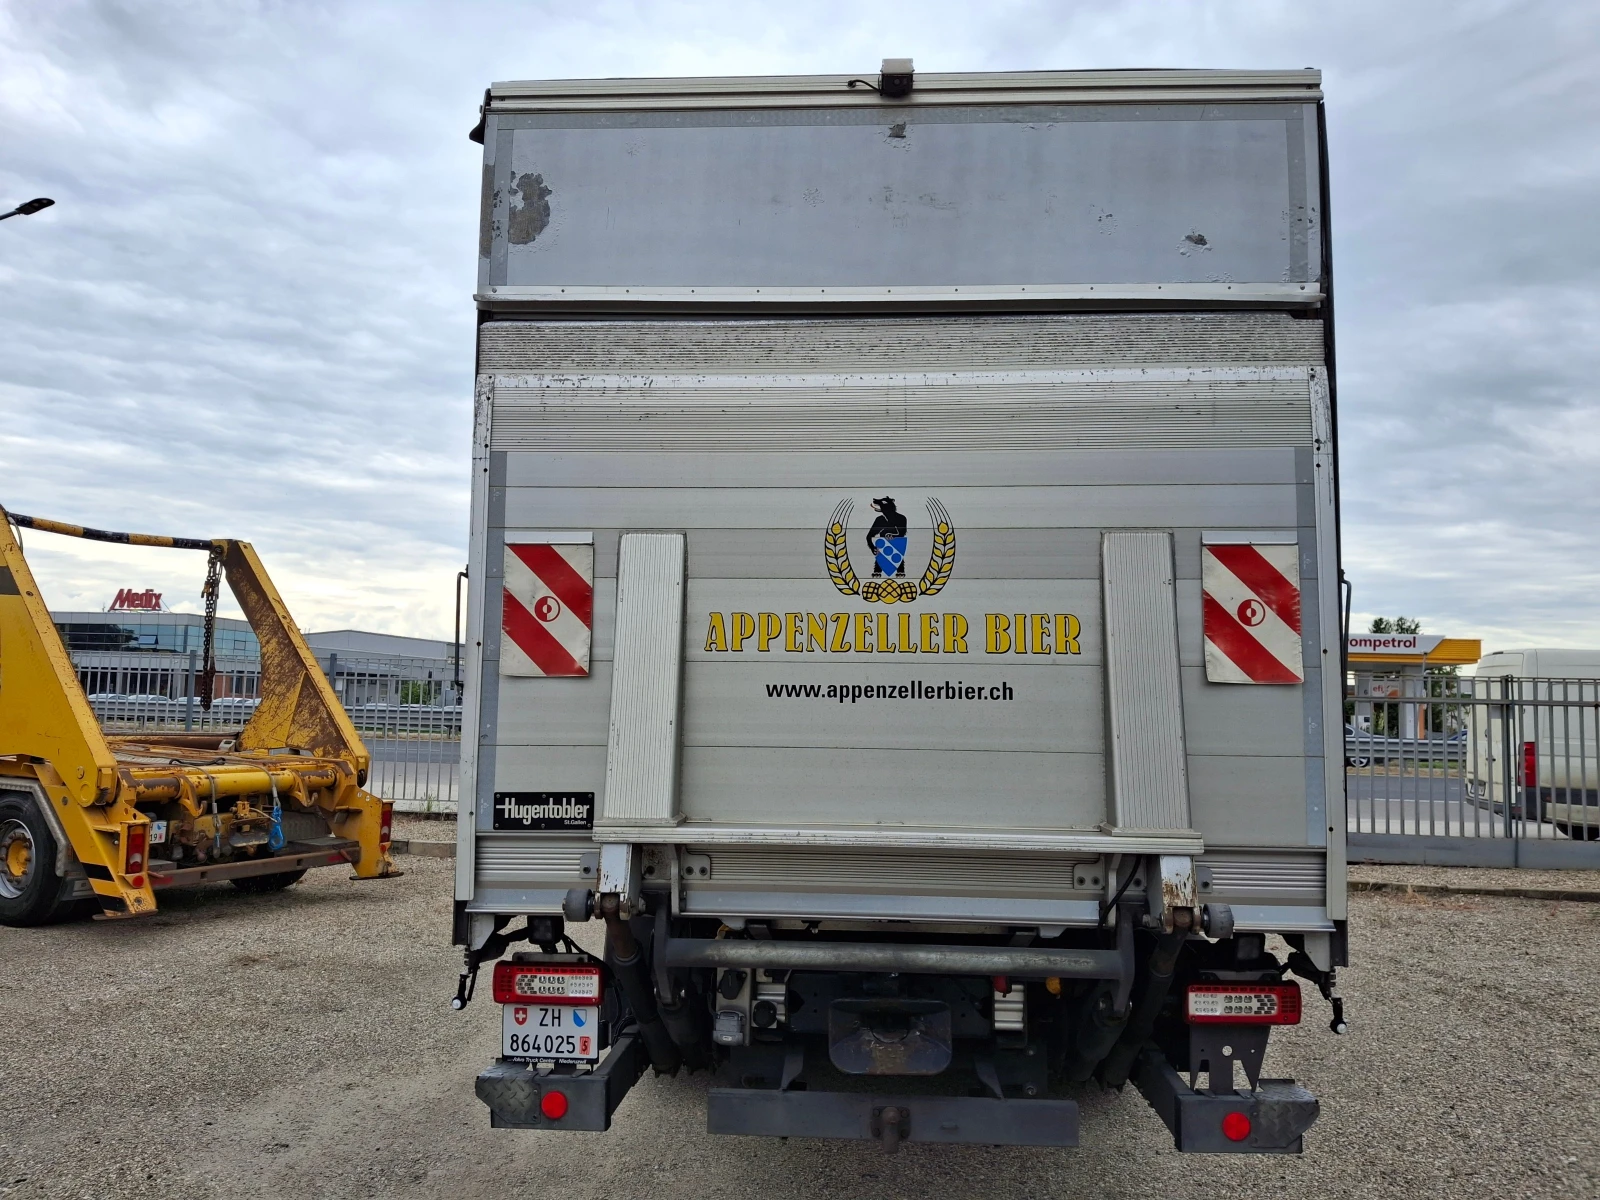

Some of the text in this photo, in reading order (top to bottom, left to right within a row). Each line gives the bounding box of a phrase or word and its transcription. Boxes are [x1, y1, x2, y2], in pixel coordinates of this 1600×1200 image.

[108, 588, 162, 611] Medix
[704, 611, 1082, 655] APPENZELLER BIER
[1347, 636, 1416, 651] ompetrol
[766, 680, 1014, 703] www.appenzellerbier.ch
[496, 797, 590, 825] Hugentobler
[539, 1008, 561, 1027] ZH
[510, 1034, 575, 1053] 864025
